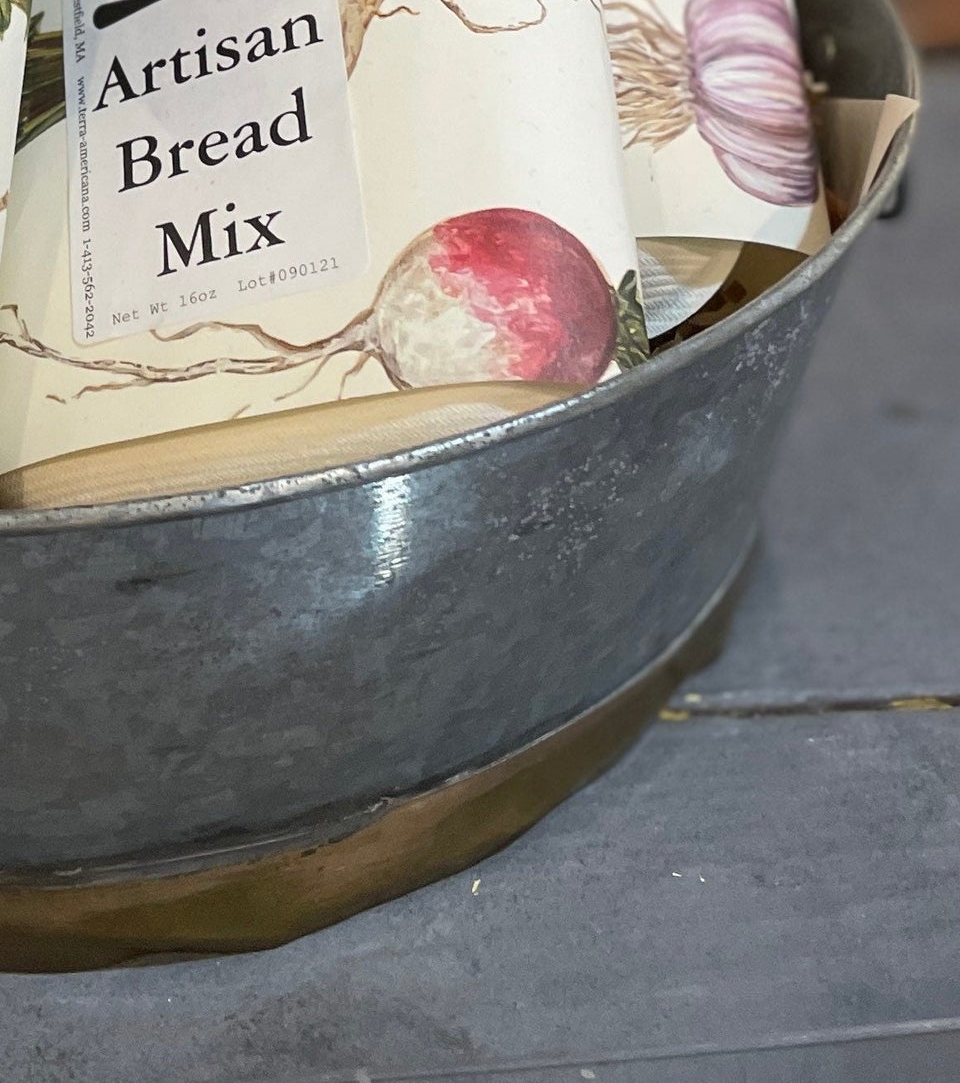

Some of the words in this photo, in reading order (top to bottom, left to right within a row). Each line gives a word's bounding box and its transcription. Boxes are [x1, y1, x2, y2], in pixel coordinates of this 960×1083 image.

[73, 41, 86, 64] MA
[91, 13, 324, 112] Artisan
[77, 75, 92, 233] www.terra-americana.com
[115, 86, 313, 193] Bread
[82, 239, 96, 339] 1-413-562-2042
[154, 202, 286, 278] Mix
[111, 309, 140, 326] Net
[149, 300, 169, 315] Wt
[179, 288, 218, 308] 16oz
[237, 256, 339, 292] Lot#090121
